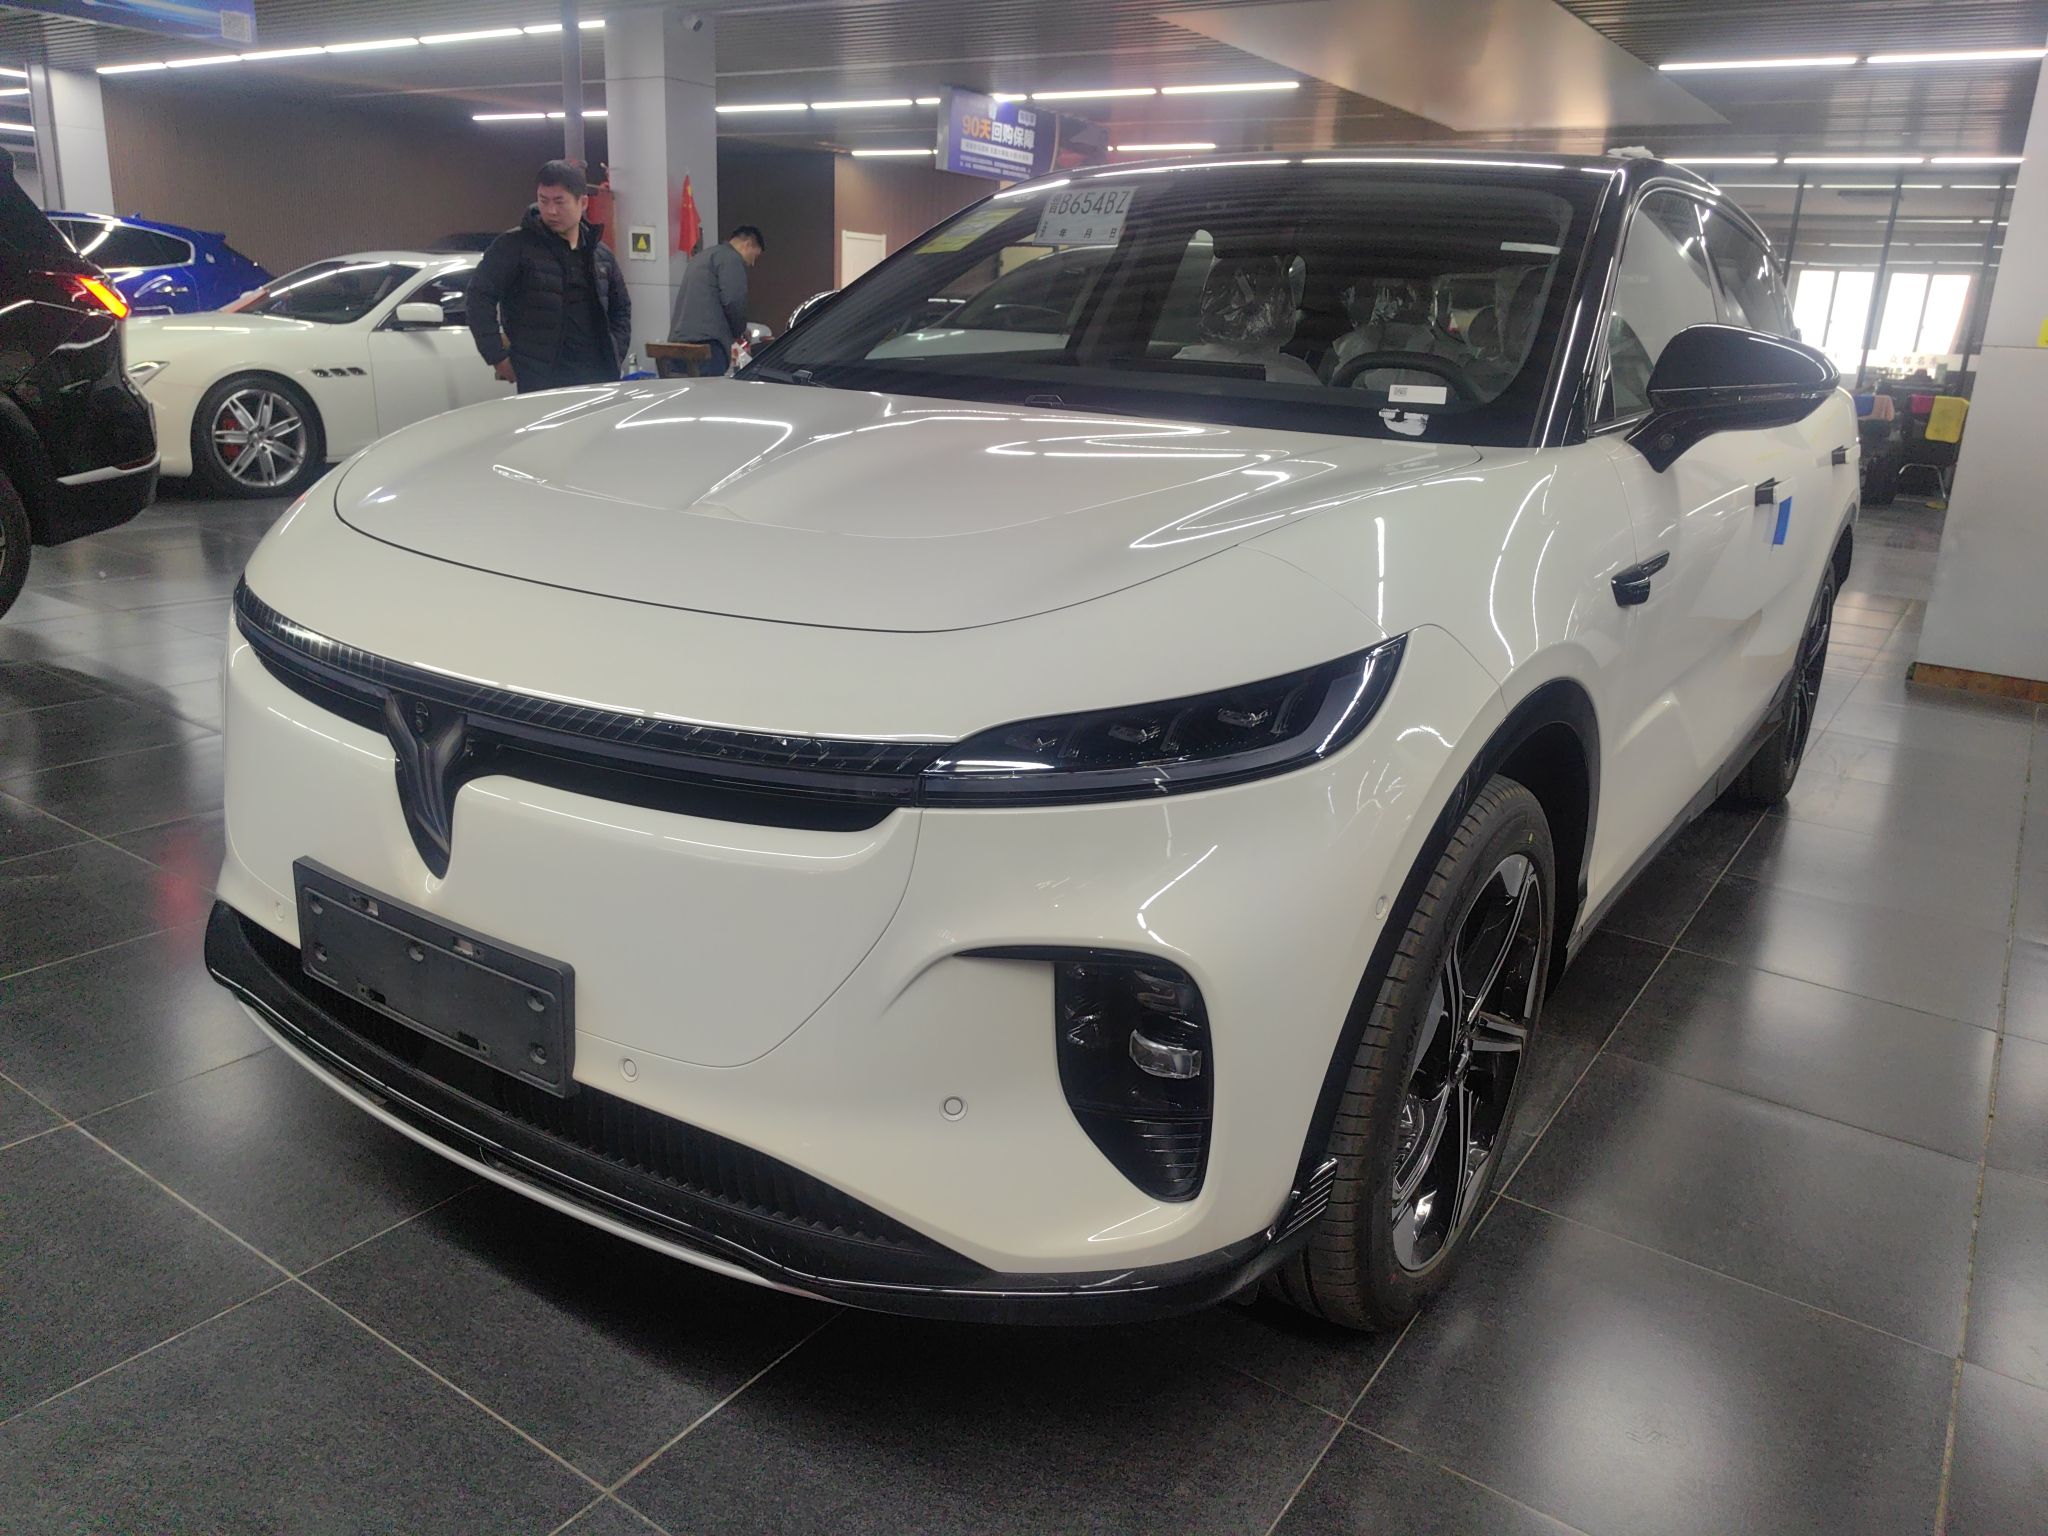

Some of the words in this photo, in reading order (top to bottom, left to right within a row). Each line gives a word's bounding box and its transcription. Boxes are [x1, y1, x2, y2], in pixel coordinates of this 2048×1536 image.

[962, 115, 1036, 150] 90天回购保障
[1059, 228, 1068, 238] 年
[1084, 228, 1093, 239] 月
[1109, 227, 1118, 238] 日
